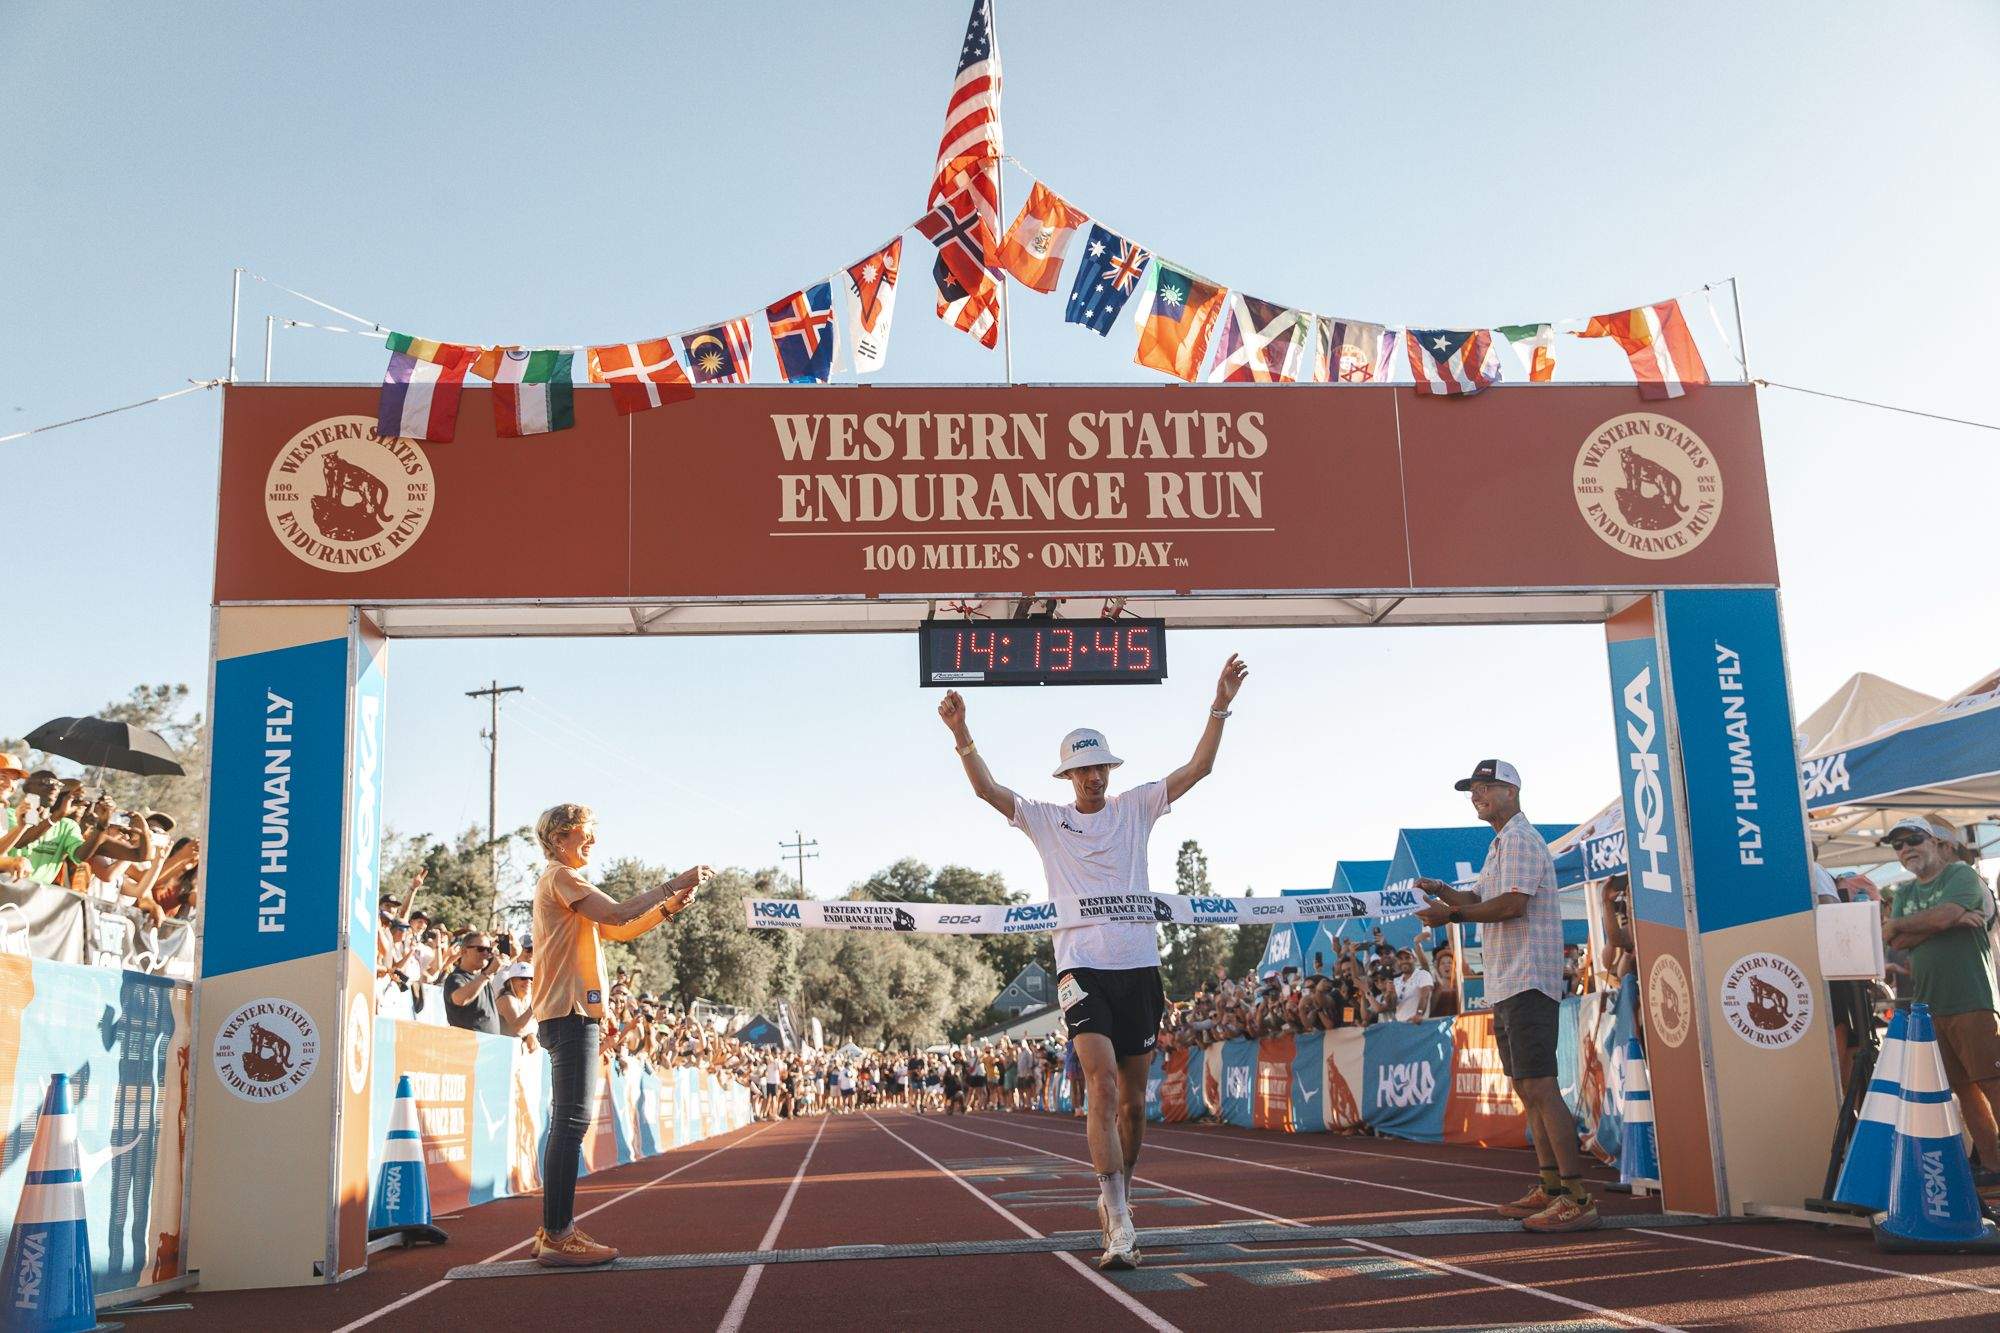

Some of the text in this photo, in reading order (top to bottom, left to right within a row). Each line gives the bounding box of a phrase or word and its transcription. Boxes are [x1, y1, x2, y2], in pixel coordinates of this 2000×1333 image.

[280, 423, 363, 475] WESTERN
[770, 409, 1268, 462] WESTERN STATES
[1583, 420, 1708, 469] WESTERN STATES
[269, 493, 299, 501] MILES
[407, 483, 428, 492] ONE
[408, 493, 427, 501] DAY
[777, 471, 1264, 523] ENDURANCE RUN
[1577, 486, 1604, 494] MILES
[277, 509, 424, 565] ENDURANCE RUN
[1587, 500, 1714, 552] ENDURANCE RUN
[863, 544, 916, 571] 100
[922, 543, 1020, 570] MILES
[1041, 542, 1105, 568] ONE
[1113, 541, 1173, 567] DAY
[1072, 739, 1099, 752] HOKA
[1716, 644, 1764, 866] FLY HUMAN FLY
[1624, 666, 1672, 893] HOKA
[1801, 753, 1850, 800] OKA
[258, 690, 293, 933] FLY HUMAN FLY
[355, 696, 380, 933] HOKA
[1591, 832, 1627, 871] HOK
[753, 902, 801, 919] HOKA
[823, 906, 894, 915] WESTERN STATES
[1005, 902, 1058, 922] HOKA
[1079, 895, 1152, 907] WESTERN STATES
[1080, 904, 1152, 916] ENDURANCE RUN
[1190, 899, 1238, 913] HOKA
[1252, 906, 1284, 914] 2024
[1326, 895, 1349, 904] STATES
[1380, 891, 1417, 906] HOKA
[824, 915, 892, 924] ENDURANCE RUN
[938, 915, 981, 924] 2024
[1017, 923, 1046, 931] HUMAN
[1727, 957, 1805, 990] WESTERN STATES
[223, 1003, 312, 1039] WESTERN STATES
[1730, 1011, 1808, 1045] ENDURANCE RUN
[221, 1060, 312, 1098] ENDURANCE RUN
[1377, 1060, 1435, 1108] HOKA
[386, 1165, 402, 1211] HOKA
[1921, 1150, 1951, 1218] HOKA
[15, 1231, 48, 1310] HOKA
